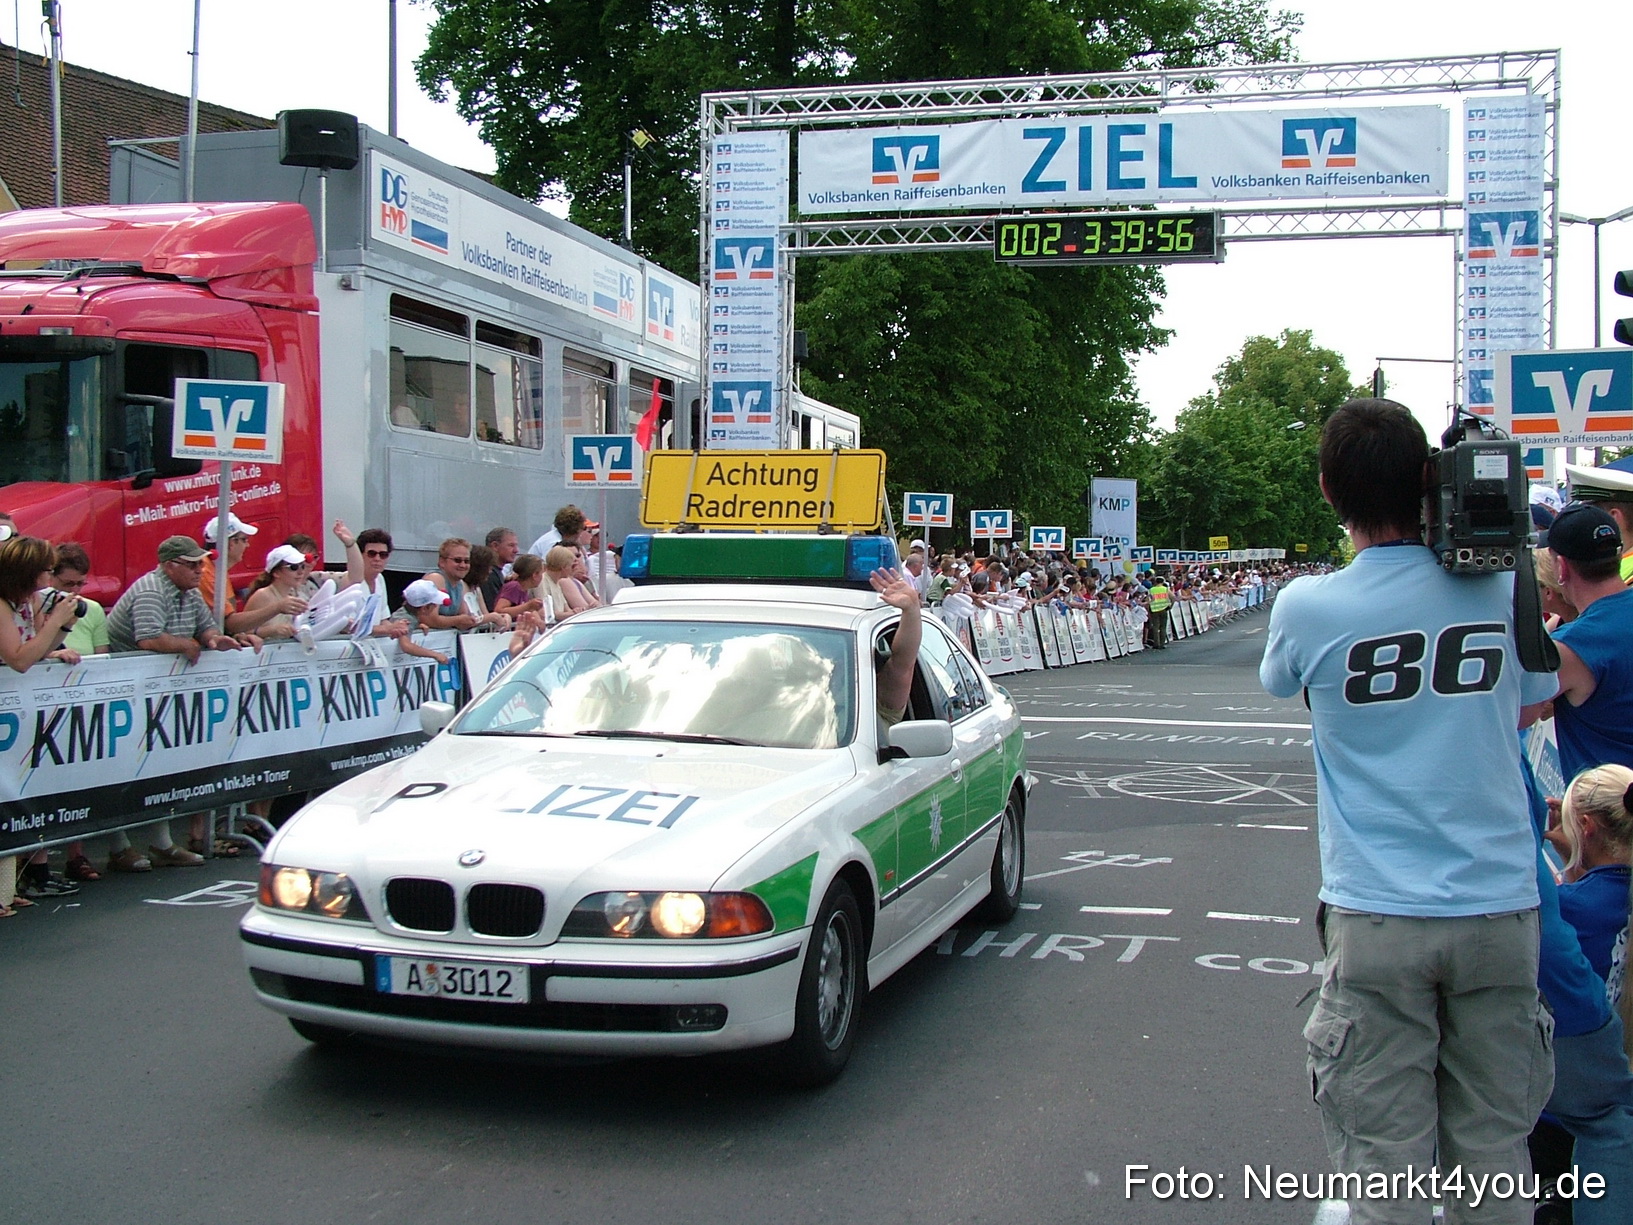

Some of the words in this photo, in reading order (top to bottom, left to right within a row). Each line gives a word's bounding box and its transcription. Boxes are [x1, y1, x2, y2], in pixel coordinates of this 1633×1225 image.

[1021, 122, 1198, 194] ZIEL
[807, 189, 889, 204] Volksbanken
[893, 182, 1006, 201] Raiffeisenbanken
[1211, 174, 1300, 188] Volksbanken
[1305, 171, 1430, 186] Raiffeisenbanken
[506, 231, 537, 260] Partner
[538, 245, 552, 267] der
[1000, 223, 1062, 256] 002
[461, 240, 519, 280] Volksbanken
[520, 265, 588, 306] Raiffeisenbanken
[164, 464, 261, 493] www.mikrunk.de
[706, 462, 819, 492] Achtung
[125, 504, 168, 526] e-Mail:
[170, 481, 281, 517] mikro-fu@t-online.de
[686, 493, 835, 519] Radrennen
[1100, 497, 1130, 511] KMP
[1344, 621, 1507, 706] 86
[34, 693, 55, 702] HIGH
[64, 690, 86, 699] TECH
[95, 684, 135, 696] PRODUCTS
[237, 677, 311, 736] KMP
[319, 670, 387, 724] KMP
[30, 699, 133, 769] KMP
[145, 688, 230, 752] KMP
[331, 751, 386, 771] www.kmp.com
[144, 782, 215, 806] www.kmp.com
[223, 774, 256, 791] InkJet
[263, 770, 291, 784] Toner
[366, 782, 701, 829] PIZEI
[11, 814, 46, 832] InkJet
[58, 806, 90, 824] Toner
[406, 963, 428, 991] A
[442, 966, 513, 998] 3012
